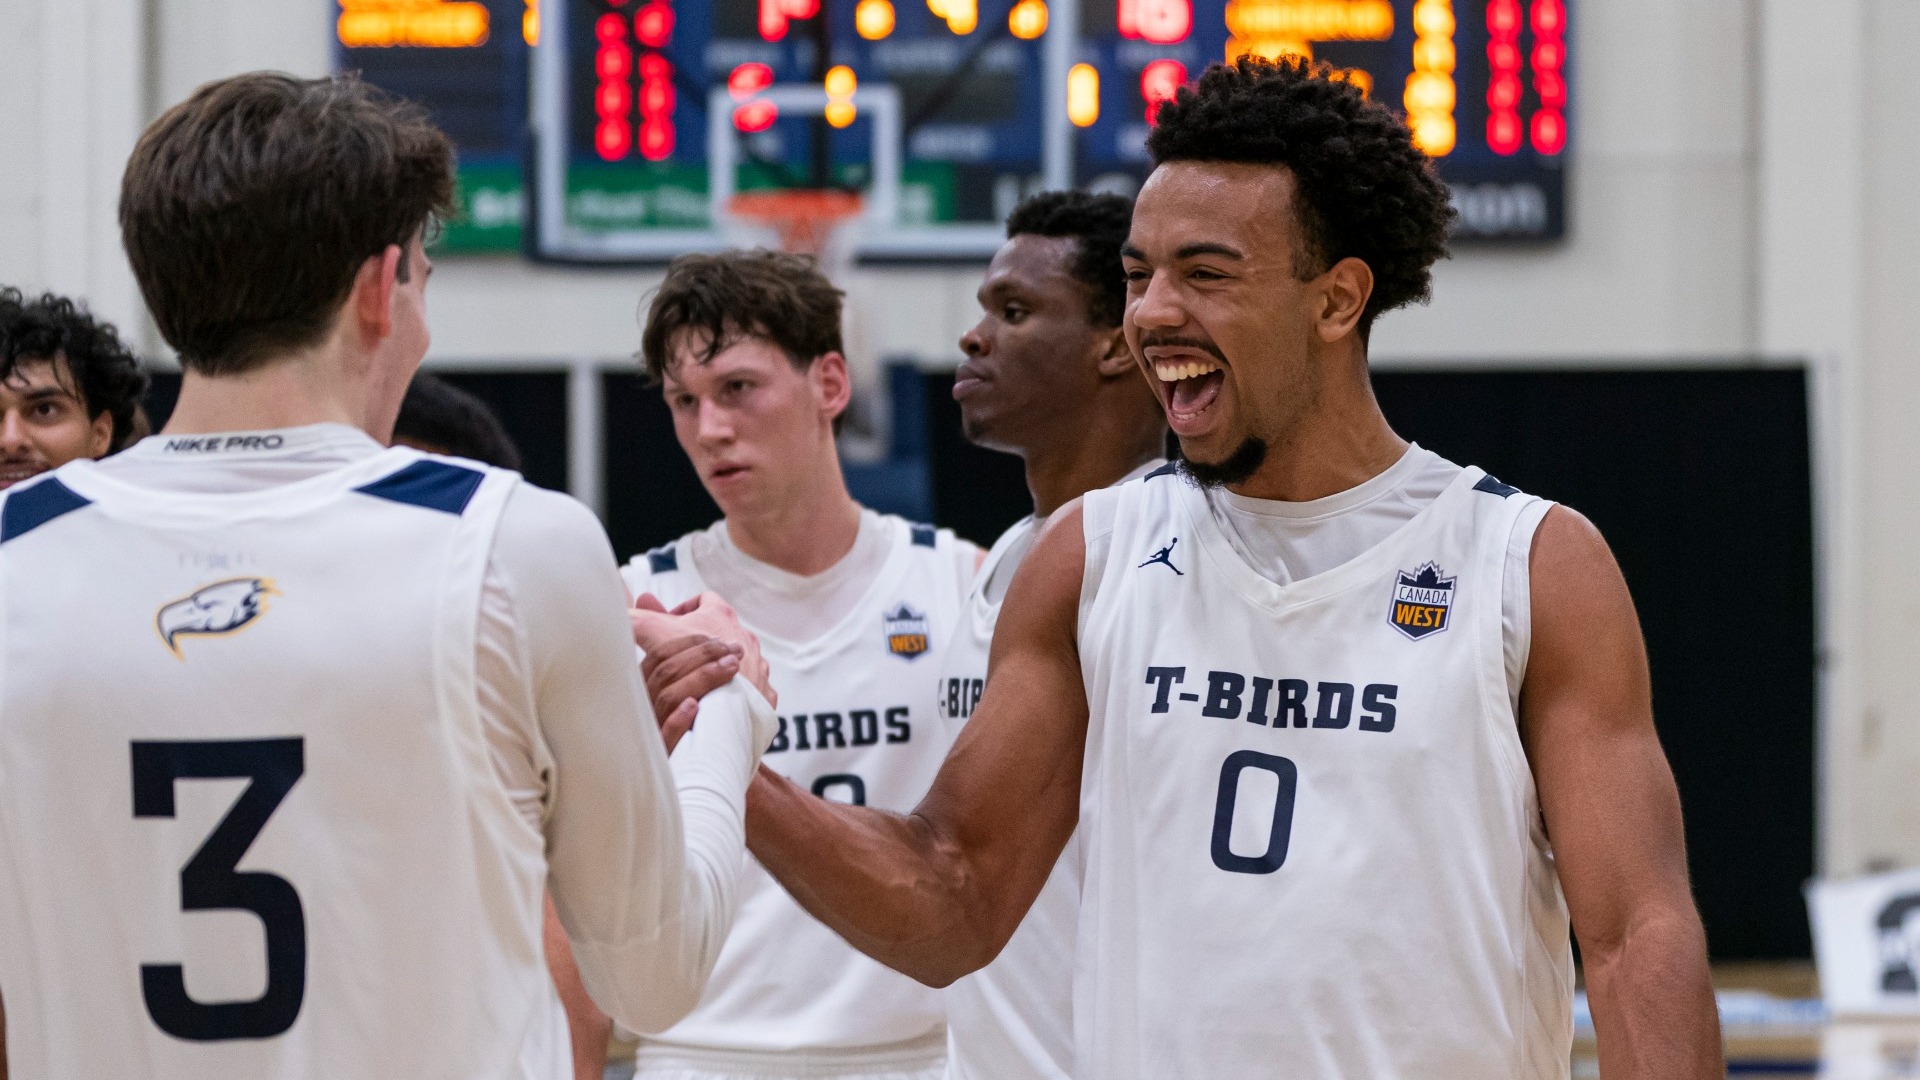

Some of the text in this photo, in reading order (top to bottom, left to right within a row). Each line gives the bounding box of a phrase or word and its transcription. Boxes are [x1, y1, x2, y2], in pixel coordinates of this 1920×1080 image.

[164, 434, 284, 452] NIKE PRO
[1396, 603, 1446, 628] WEST
[1399, 586, 1448, 605] CANADA
[1145, 666, 1399, 733] T-BIRDS
[1210, 749, 1298, 875] 0
[129, 736, 306, 1043] 3
